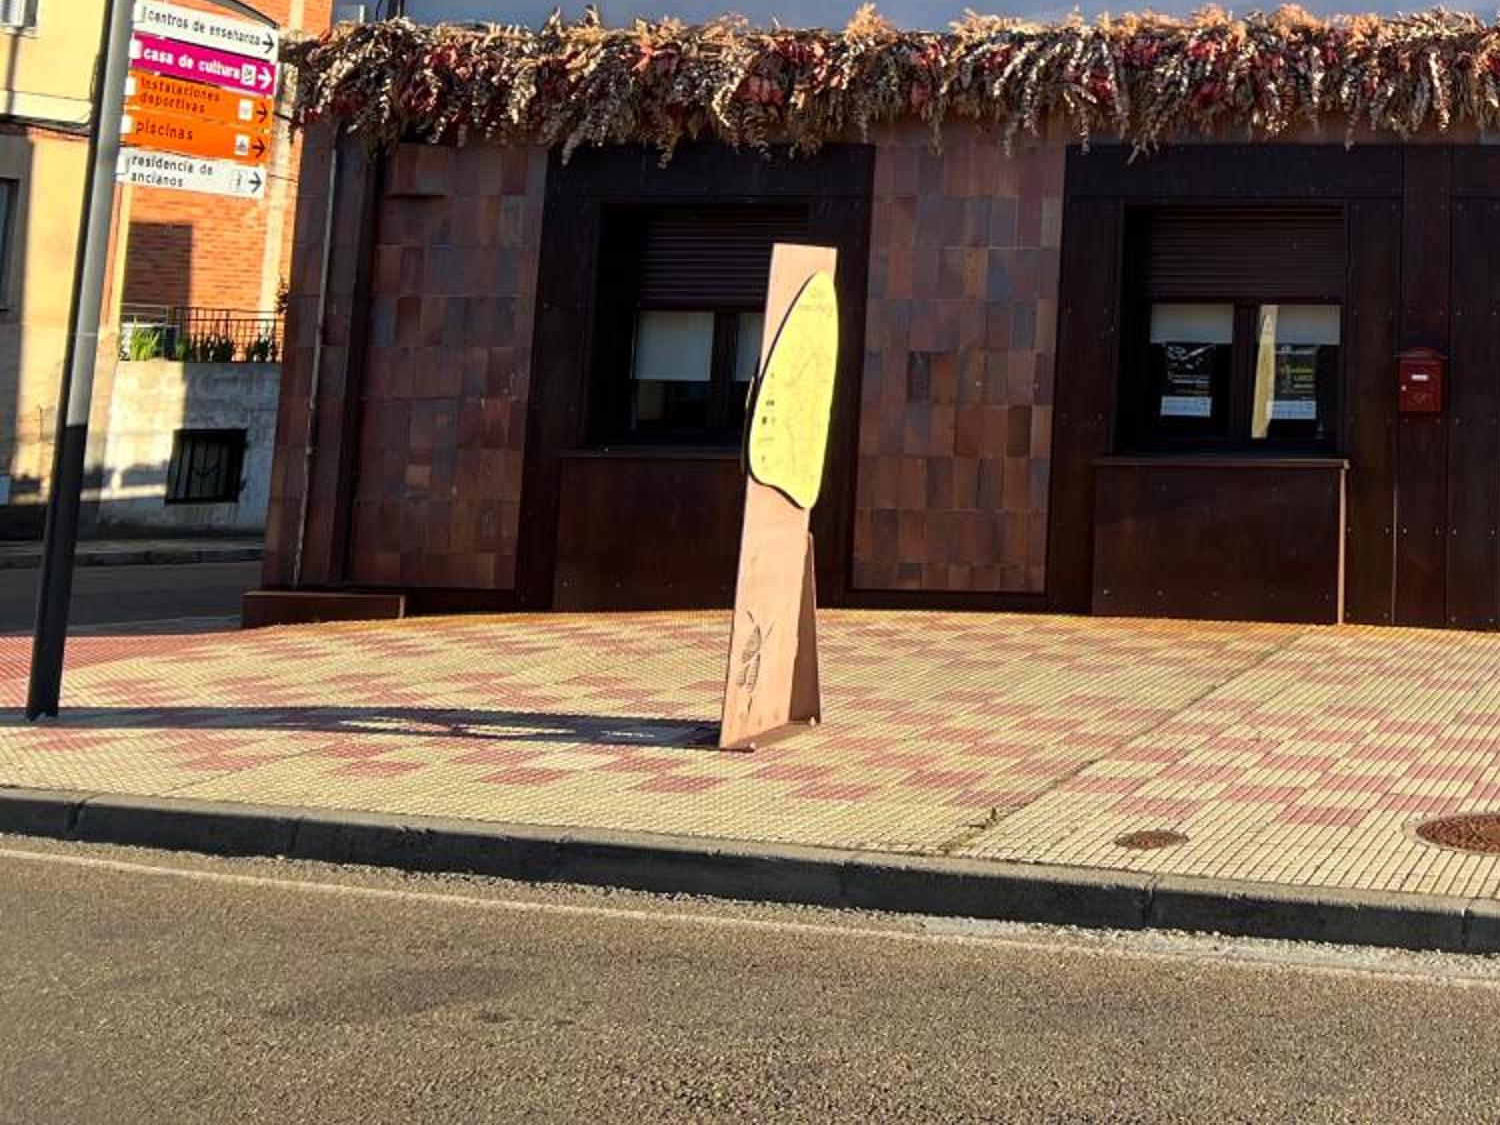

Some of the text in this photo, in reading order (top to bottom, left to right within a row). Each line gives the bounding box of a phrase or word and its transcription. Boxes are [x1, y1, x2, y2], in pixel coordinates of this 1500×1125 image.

[147, 9, 189, 30] centros
[191, 20, 206, 34] de
[143, 47, 241, 80] casa de cultura
[139, 92, 206, 114] deportivas
[136, 120, 194, 141] piscinas
[131, 153, 214, 176] residencia de
[131, 171, 184, 188] ancianos
